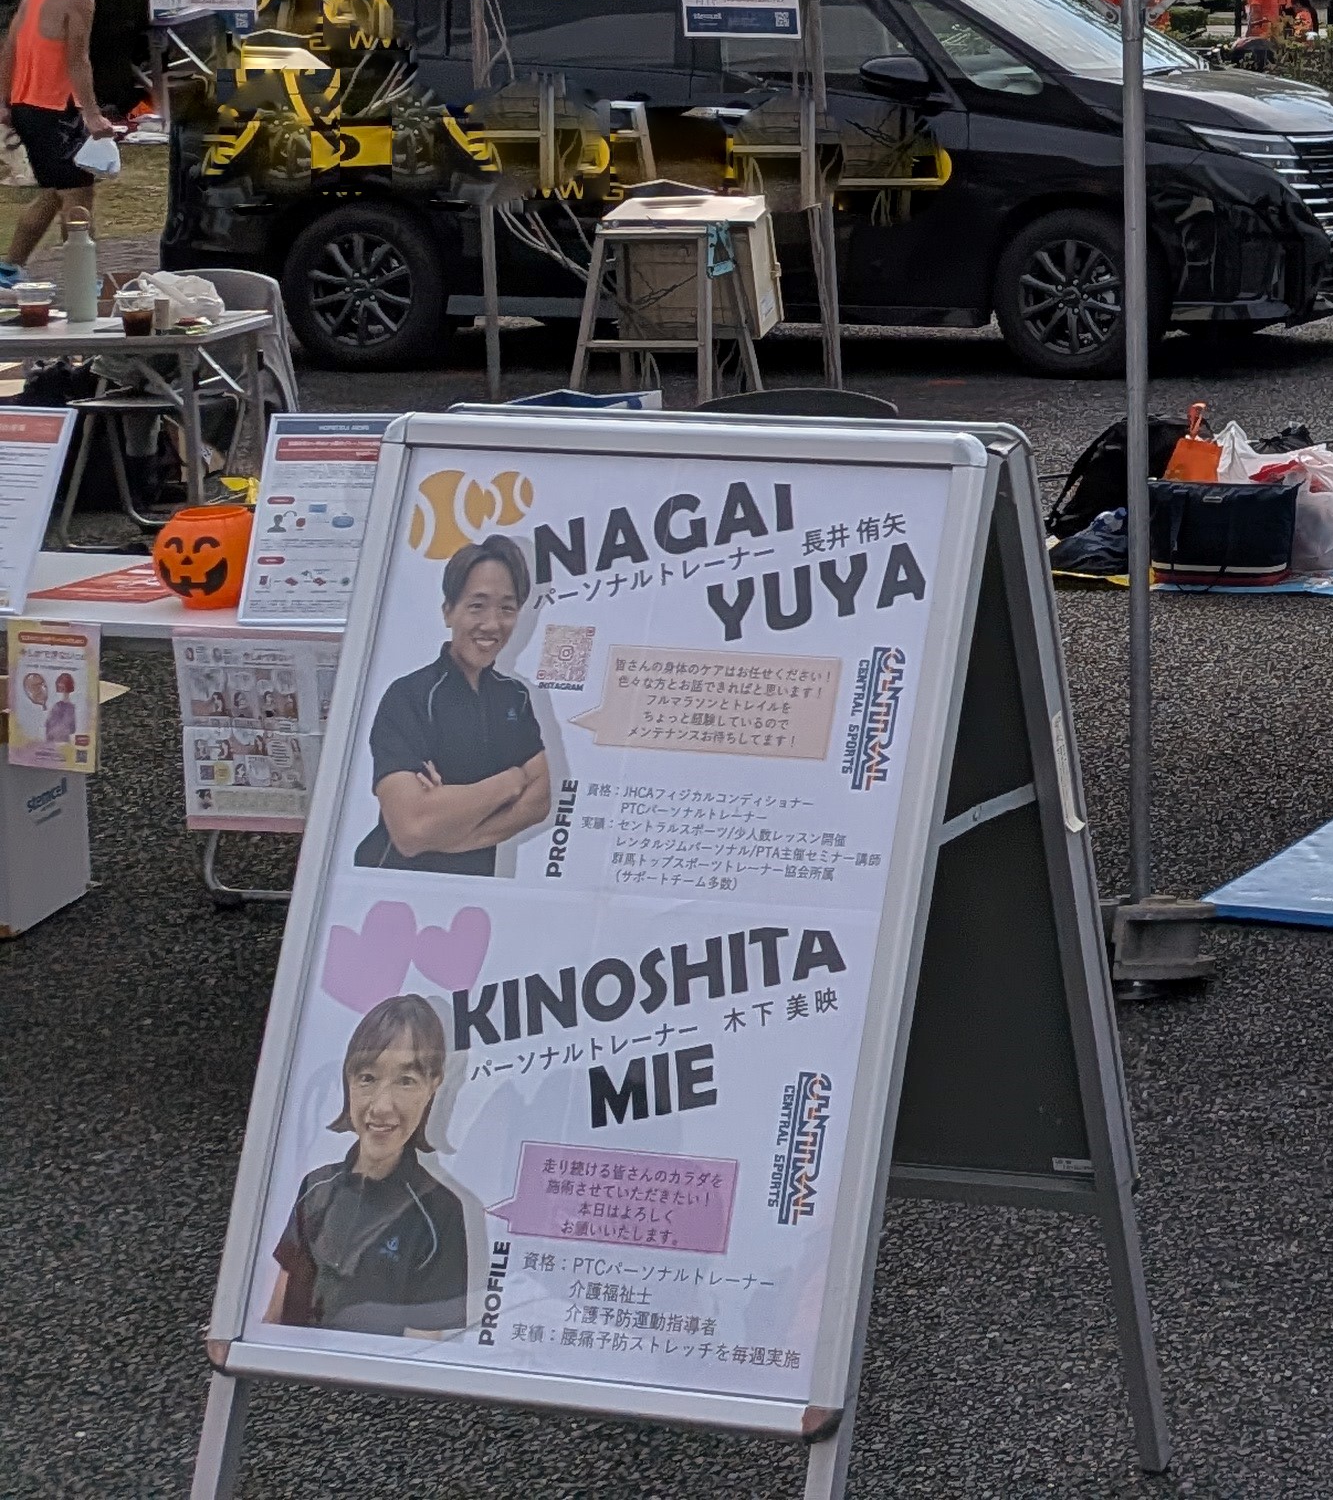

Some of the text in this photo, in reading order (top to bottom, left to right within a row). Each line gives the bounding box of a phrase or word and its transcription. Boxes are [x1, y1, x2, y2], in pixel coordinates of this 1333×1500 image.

[534, 481, 796, 584] NAGAI
[533, 546, 775, 611] パーソナルトレーナー
[706, 542, 927, 642] YUYA
[545, 779, 579, 879] PROFILE
[453, 928, 846, 1051] KINOSHITA
[470, 1023, 700, 1082] パーソナルトレーナー
[588, 1044, 718, 1129] MIE
[577, 1202, 674, 1224] 本日はよろしく
[478, 1240, 513, 1347] PROFILE
[565, 1303, 718, 1336] 介護予防運動指導者
[569, 1280, 653, 1306] 介護福祉士
